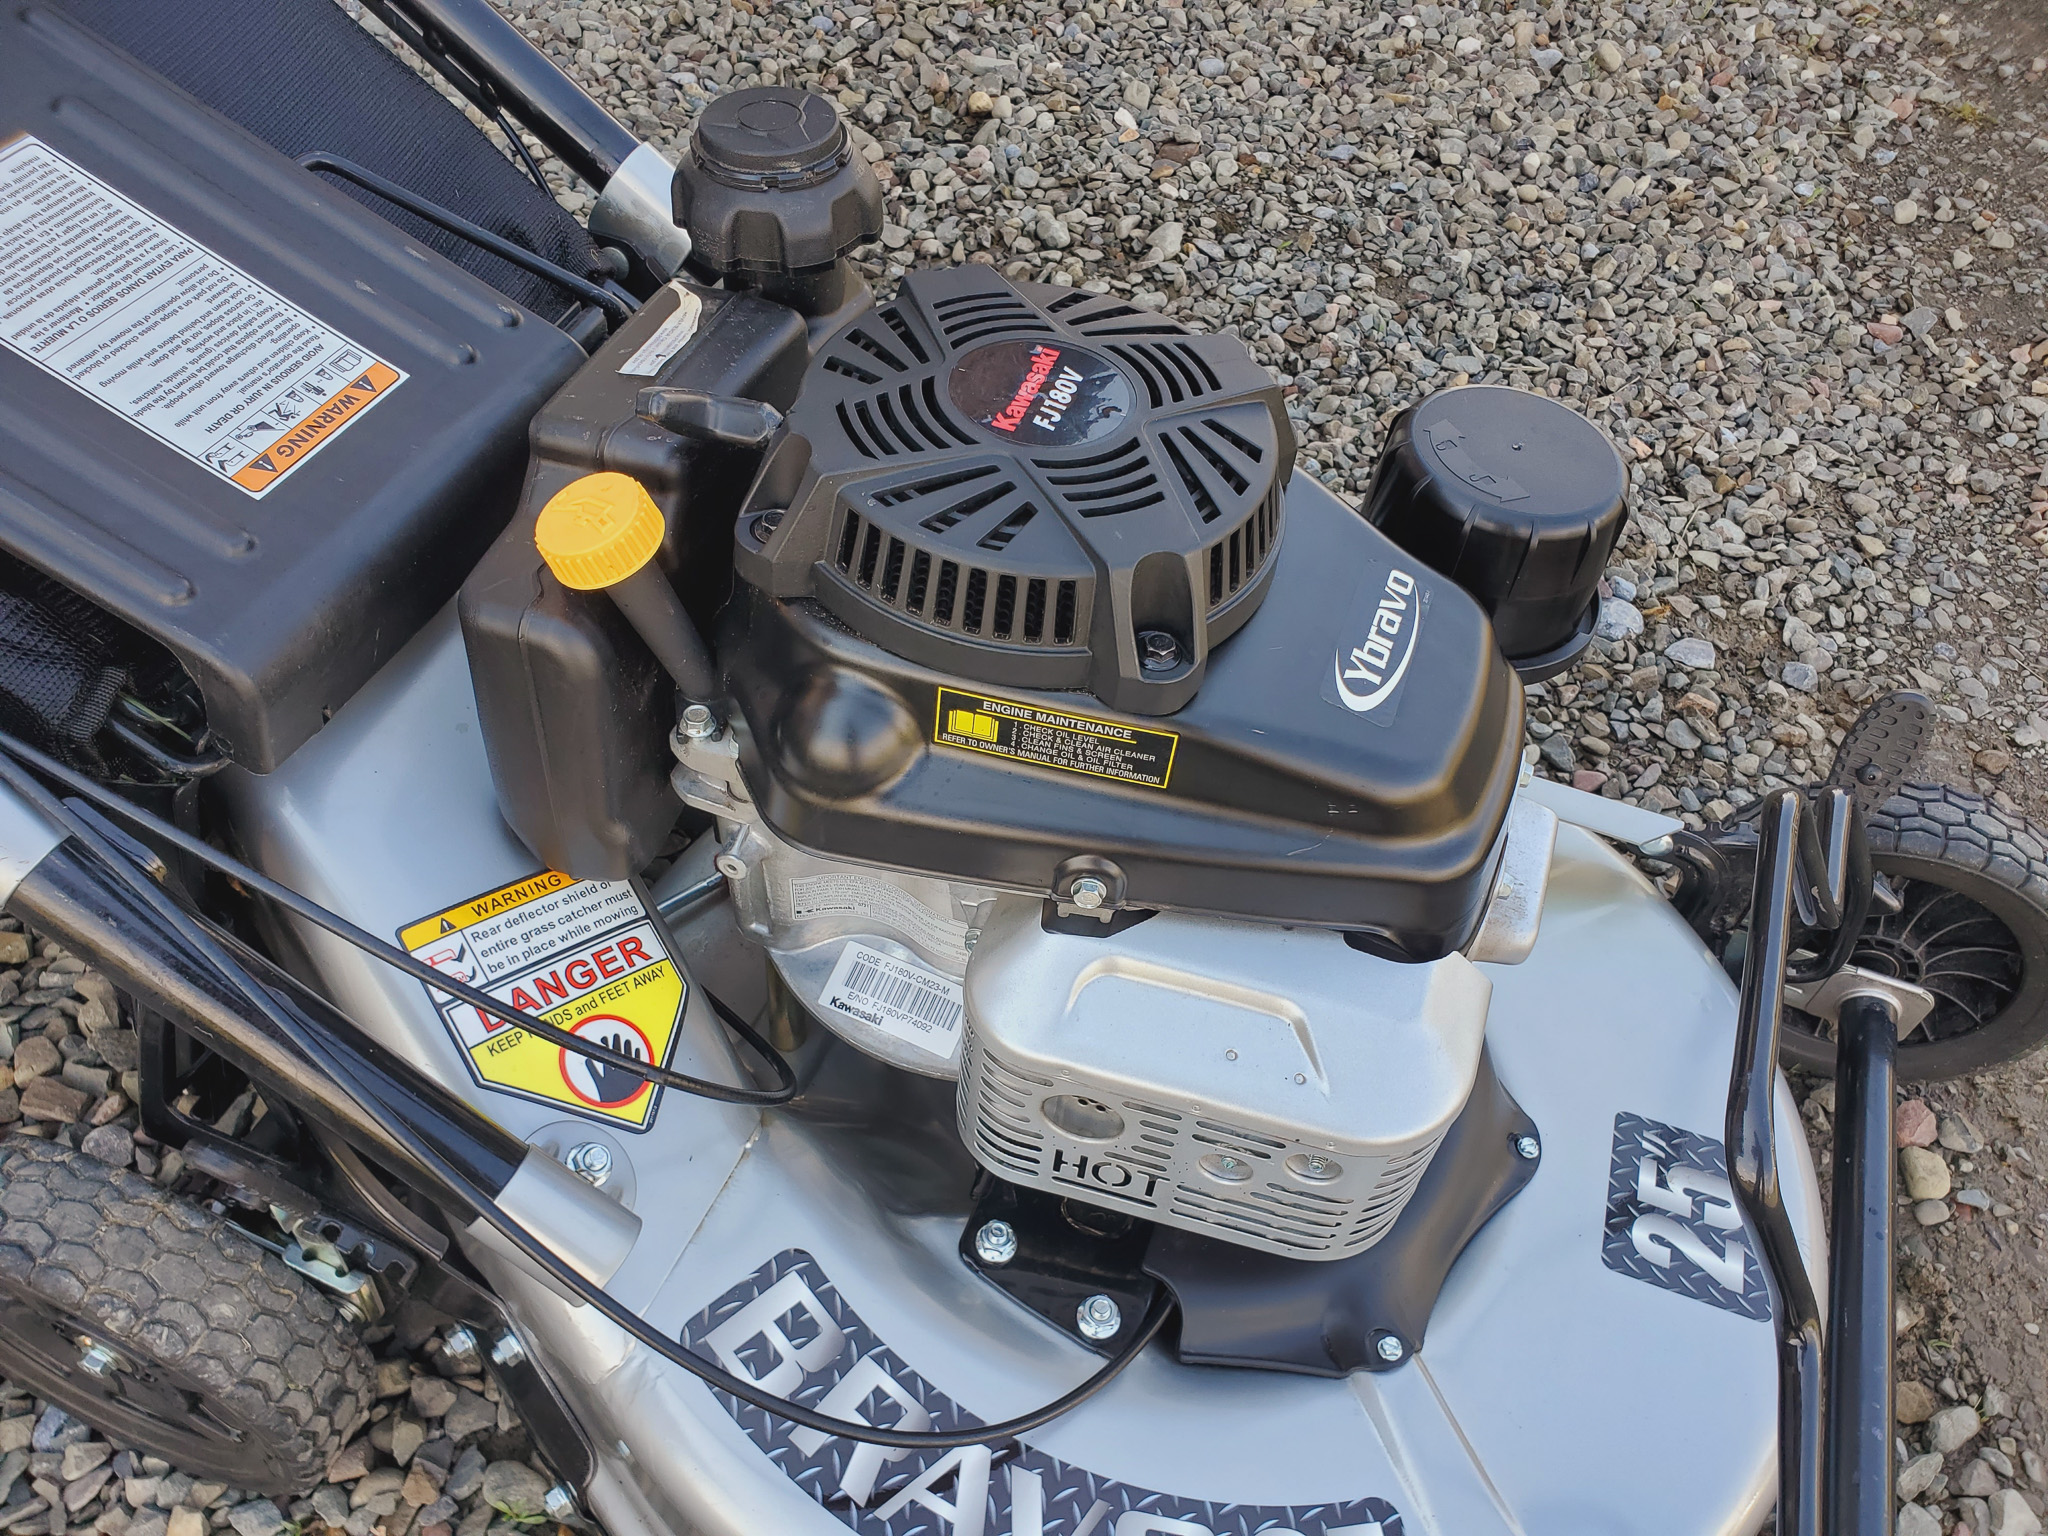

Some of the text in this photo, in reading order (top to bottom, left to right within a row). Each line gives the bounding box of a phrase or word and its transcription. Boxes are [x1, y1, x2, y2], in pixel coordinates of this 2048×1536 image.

[169, 246, 193, 261] PARA
[142, 259, 173, 280] EVITAR
[174, 262, 209, 287] personnel.
[216, 275, 229, 283] Do
[190, 288, 207, 300] park
[204, 281, 218, 291] not
[204, 281, 238, 304] backward.
[85, 295, 118, 317] SERIOS
[159, 308, 178, 321] slope
[255, 304, 274, 317] Keep
[64, 320, 80, 330] LA
[65, 269, 219, 373] Do not allow operation of the mower by untrained
[137, 320, 161, 336] unless
[147, 293, 256, 367] Go across slopes, not up and down.
[212, 325, 226, 336] and
[225, 312, 243, 327] place
[236, 316, 257, 331] safety
[29, 328, 68, 353] MUERTE
[98, 287, 247, 387] Look down and behind before and while moving
[185, 334, 214, 353] working.
[213, 329, 238, 347] devices
[269, 322, 300, 344] operating.
[301, 333, 320, 347] Read
[109, 335, 139, 356] chocked
[291, 345, 304, 354] the
[301, 343, 324, 361] AVOID
[71, 359, 104, 380] blocked.
[127, 310, 284, 421] Remove objects that could be thrown by the blade.
[160, 316, 293, 408] Never direct discharge toward other people.
[270, 359, 303, 384] SERIOUS
[159, 365, 188, 383] shields,
[173, 328, 311, 427] Keep children and others away from unit while
[236, 375, 263, 394] manual.
[128, 383, 163, 404] switches,
[991, 345, 1061, 432] Kawasaki
[1033, 366, 1084, 432] FJ180V
[229, 404, 245, 414] OR
[204, 412, 233, 433] DEATH
[276, 394, 360, 457] WARNING
[1343, 569, 1415, 686] Ybravo
[983, 700, 1132, 739] ENGINE MAINTENANCE
[1023, 723, 1053, 735] CHECK
[1055, 730, 1070, 738] OIL
[1072, 733, 1099, 744] LEVEL
[1020, 742, 1058, 756] CHANGE
[1060, 751, 1075, 759] OIL
[1086, 756, 1100, 764] OIL
[1102, 759, 1133, 770] FILTER
[1021, 736, 1051, 748] CLEAN
[1053, 742, 1073, 752] FINS
[1084, 749, 1122, 762] SCREEN
[1022, 729, 1053, 741] CHECK
[1064, 738, 1093, 750] CLEAN
[1095, 745, 1111, 753] AIR
[1113, 748, 1155, 762] CLEANER
[942, 732, 1160, 783] REFER TO OWNER'S MANUAL FOR FURTHER INFORMATION
[470, 874, 561, 916] WARNING
[470, 924, 501, 942] Rear
[504, 900, 559, 928] deflector
[561, 883, 598, 905] shield
[480, 888, 633, 957] entire grass catcher must
[486, 905, 638, 973] be in place while mowing
[856, 951, 950, 996] CODE FJ180V-CM23-M
[486, 1030, 522, 1056] KEEP
[574, 996, 598, 1015] and
[598, 980, 630, 1004] FEET
[633, 965, 664, 989] AWAY
[829, 995, 883, 1025] Kawasaki
[846, 990, 933, 1034] E/NO FJ180VP74092
[1052, 1149, 1170, 1198] HOT
